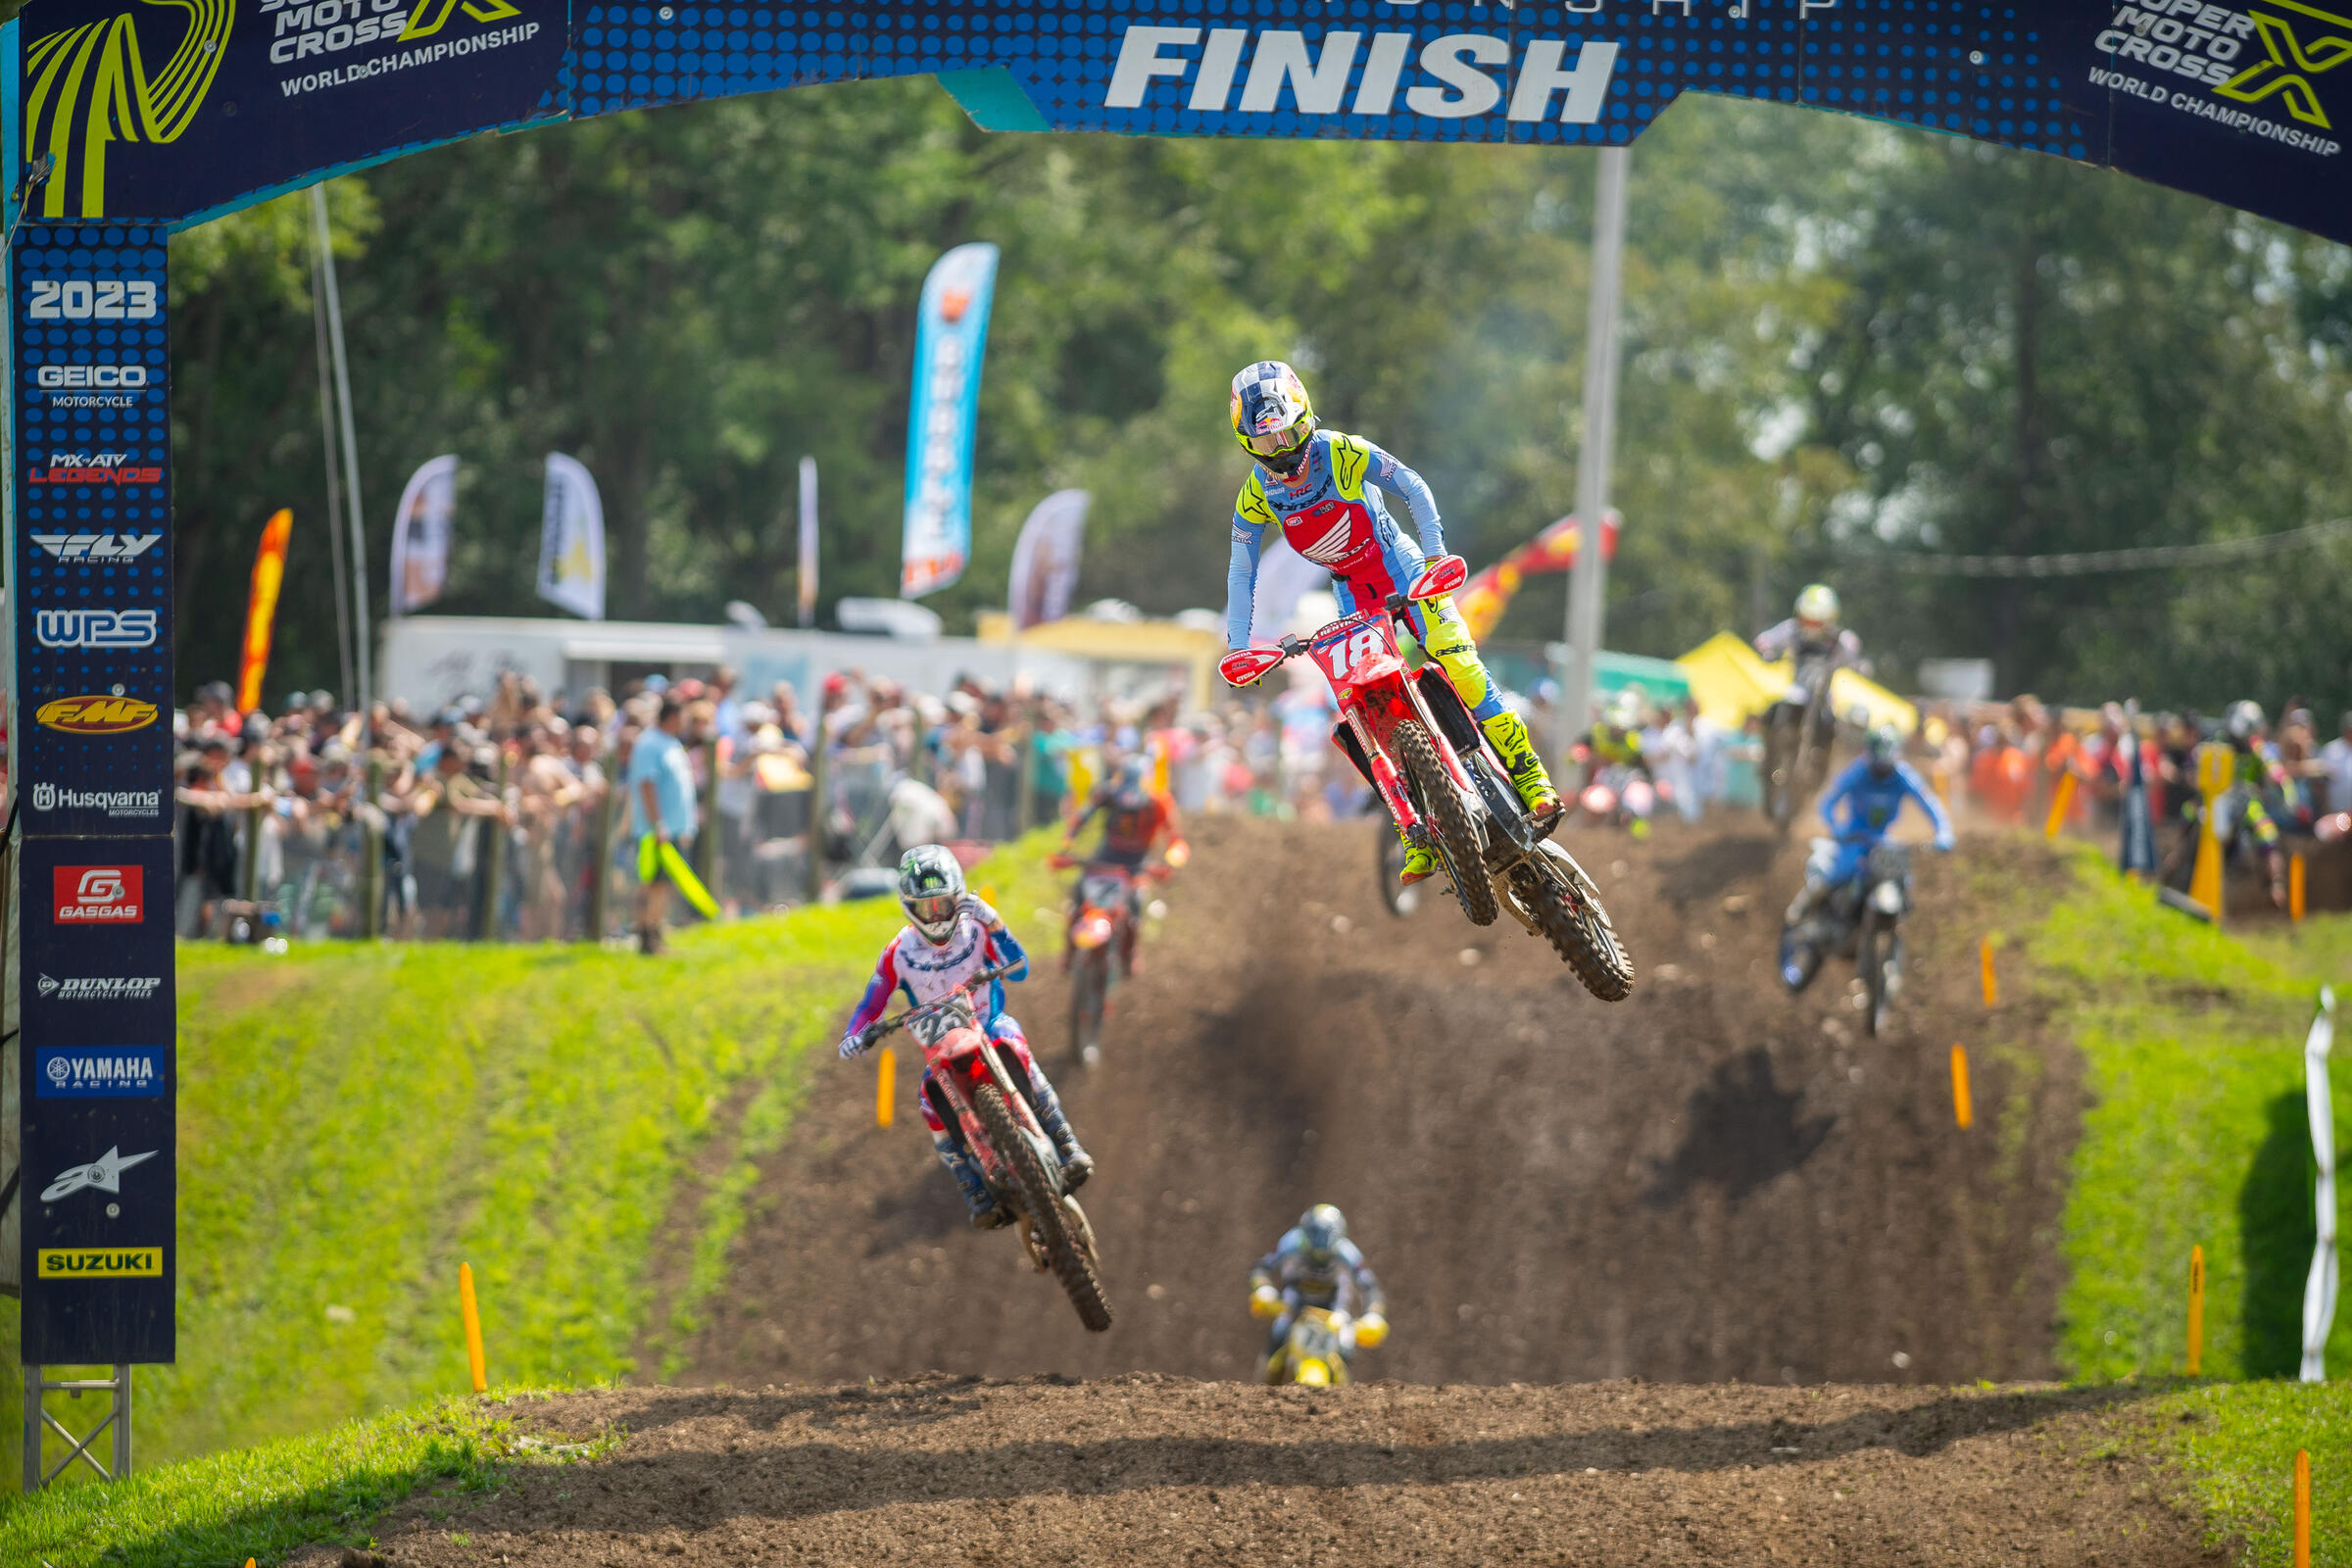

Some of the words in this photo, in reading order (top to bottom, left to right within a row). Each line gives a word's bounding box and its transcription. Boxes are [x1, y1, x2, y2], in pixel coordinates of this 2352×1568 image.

[2125, 0, 2256, 40] PER
[270, 10, 408, 64] CROSS
[2112, 6, 2242, 61] MOTO
[281, 64, 366, 97] WORLD
[366, 22, 539, 77] CHAMPIONSHIP
[2094, 29, 2236, 86] CROSS
[1104, 25, 1620, 123] FINISH
[2088, 67, 2169, 103] WORLD
[2171, 93, 2341, 157] CHAMPIONSHIP
[30, 280, 157, 318] 2023
[38, 366, 147, 387] GEICO
[52, 396, 133, 408] MOTORCYCLE
[29, 467, 162, 485] LEGENDS
[30, 534, 162, 557] FLY
[37, 610, 156, 648] WPS
[1223, 651, 1252, 663] HONDA
[1328, 626, 1385, 679] 18
[36, 701, 157, 724] FMF
[58, 789, 160, 810] Husqvarna
[1377, 779, 1401, 821] DUNLOP
[109, 808, 160, 817] MOTORCYCLES
[59, 906, 138, 918] GASGAS
[58, 990, 121, 999] MOTORCYCLE
[124, 990, 153, 999] TIRES
[61, 977, 161, 990] DUNLOP
[72, 1057, 154, 1080] YAMAHA
[46, 1253, 153, 1271] SUZUKI
